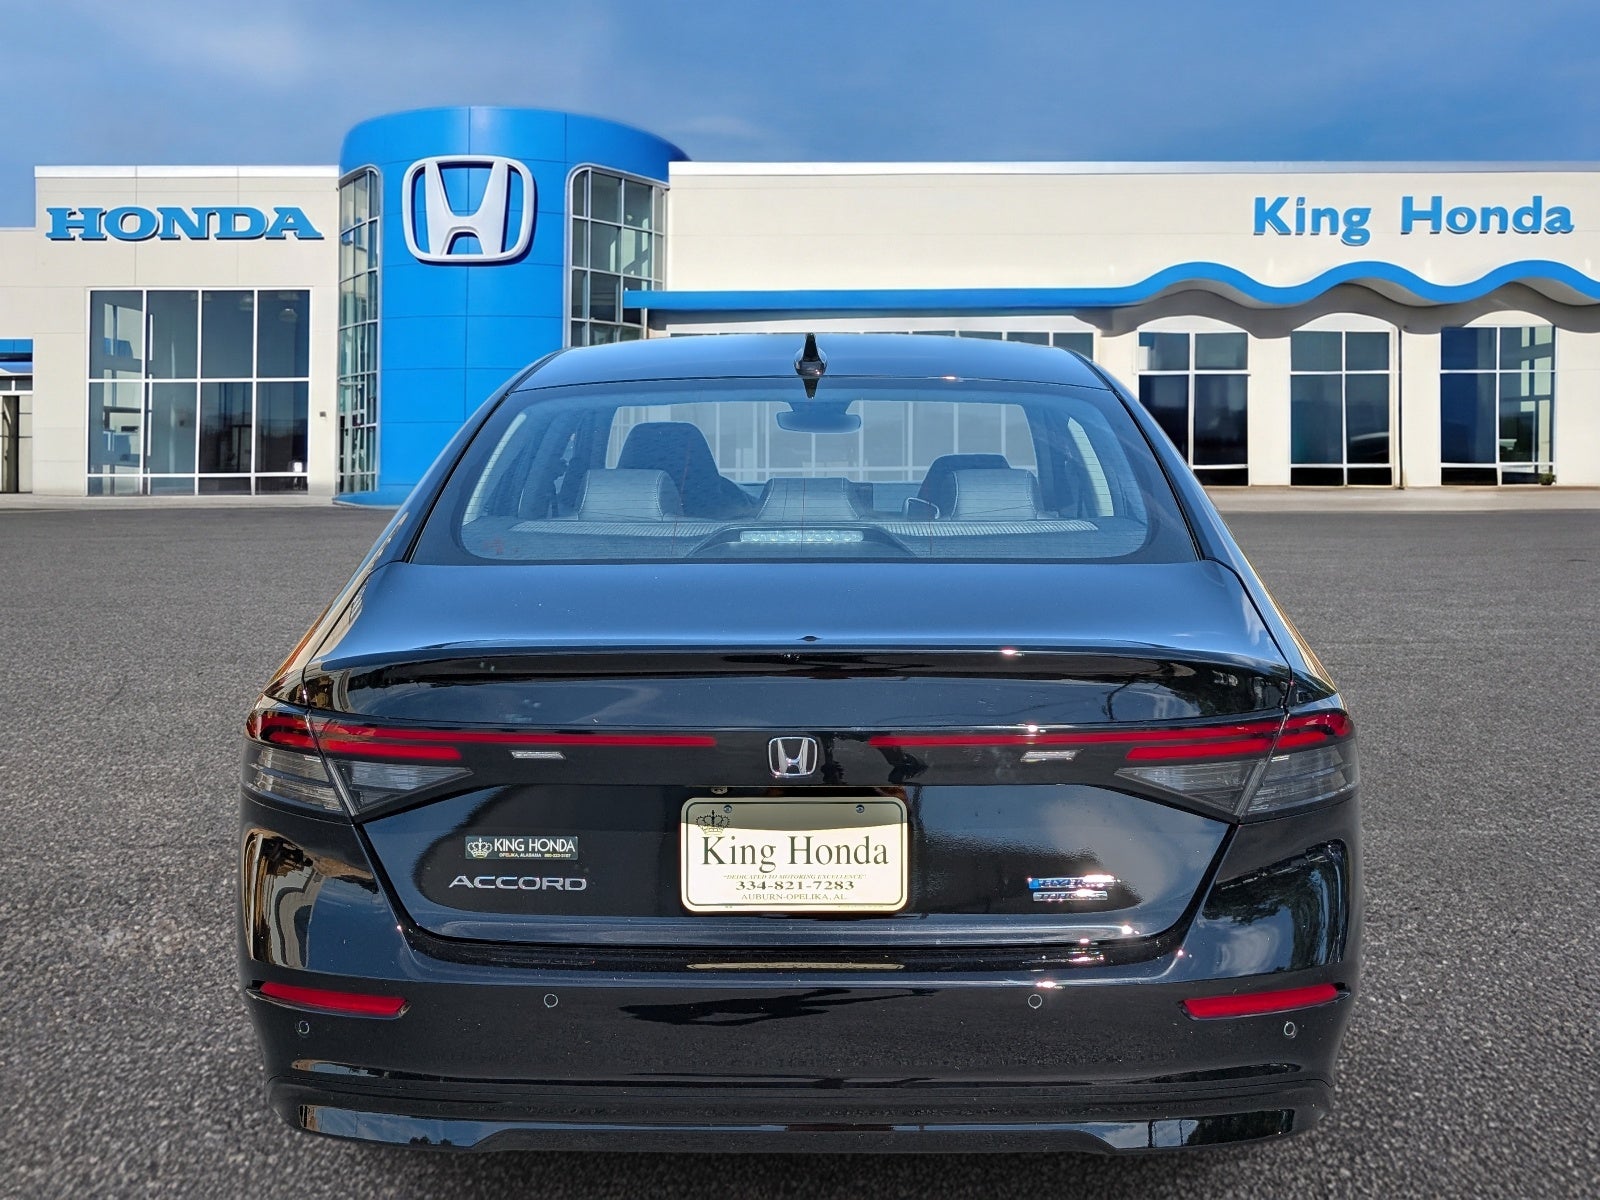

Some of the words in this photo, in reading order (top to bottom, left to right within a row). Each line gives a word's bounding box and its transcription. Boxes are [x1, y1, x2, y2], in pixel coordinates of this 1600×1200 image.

[46, 206, 324, 241] HONDA
[1253, 196, 1372, 246] King
[1400, 195, 1575, 235] Honda
[494, 838, 524, 852] KING
[528, 838, 576, 852] HONDA
[701, 835, 777, 873] King
[787, 835, 889, 866] Honda
[448, 875, 587, 891] ACCORD
[736, 880, 854, 891] 334-821-7283
